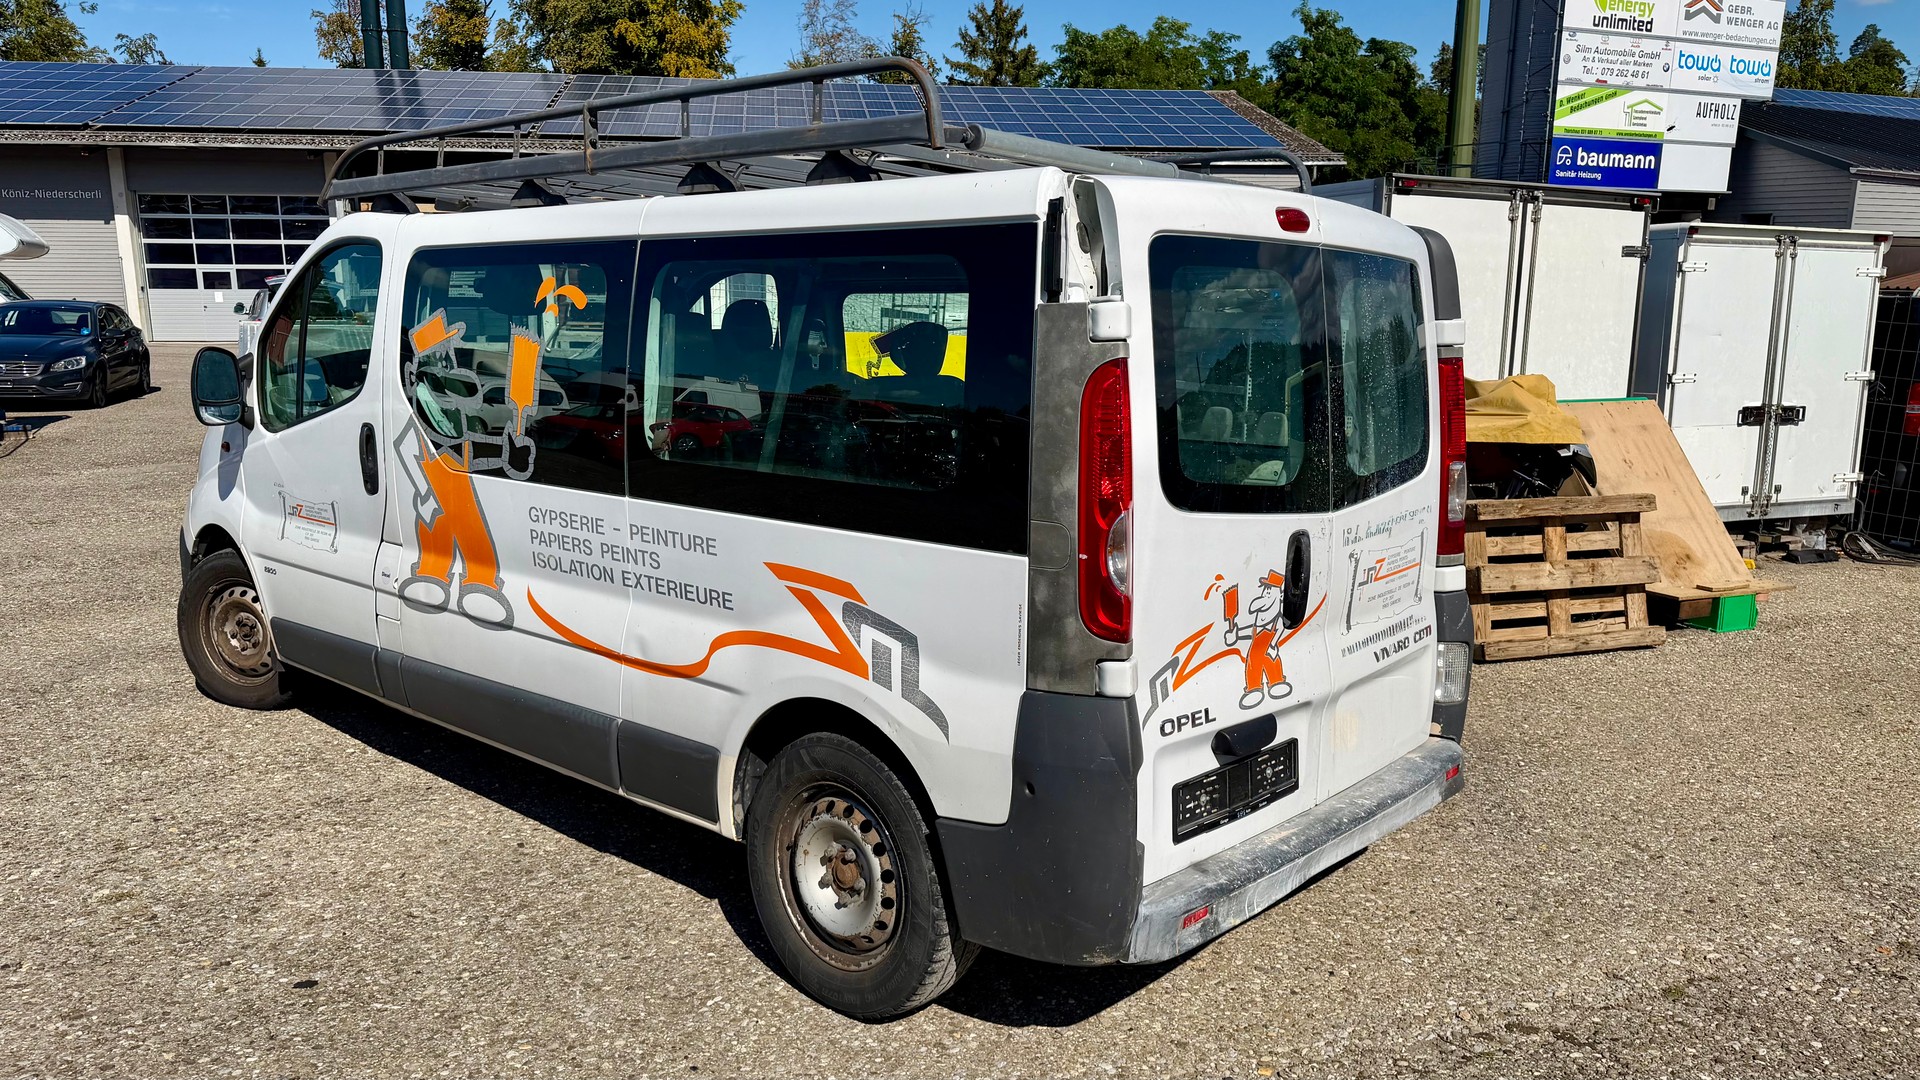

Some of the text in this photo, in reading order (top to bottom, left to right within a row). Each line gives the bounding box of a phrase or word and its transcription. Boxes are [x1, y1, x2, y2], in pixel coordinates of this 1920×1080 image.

[1608, 0, 1655, 18] energy
[1727, 4, 1755, 16] GEBR.
[1592, 13, 1654, 33] unlimited
[1726, 16, 1779, 31] WENGER AG
[1682, 29, 1778, 45] www.wenger-bedachungen.ch
[1575, 44, 1662, 60] Silm Automobile GmbH
[1581, 55, 1590, 63] An
[1597, 56, 1619, 66] Verkauf
[1619, 58, 1632, 66] aller
[1632, 60, 1653, 68] Marken
[1678, 50, 1772, 77] towa towa
[1600, 67, 1614, 77] 079
[1615, 68, 1629, 78] 262
[1630, 70, 1640, 79] 48
[1640, 71, 1650, 80] 61
[1697, 74, 1712, 82] solar
[1559, 99, 1565, 108] D.
[1569, 94, 1604, 114] Bedachungen
[1695, 102, 1737, 120] AUFHOLZ
[1576, 146, 1656, 170] baumann
[1555, 169, 1602, 180] Sanitär Heizung
[1, 188, 101, 199] Köniz-Niederscherli
[528, 506, 606, 536] GYPSERIE
[629, 523, 719, 557] PEINTURE
[529, 528, 661, 570] PAPIERS PEINTS
[532, 550, 736, 612] ISOLATION EXTERIEURE
[1373, 636, 1410, 663] VIVARO
[1159, 707, 1217, 738] OPEL
